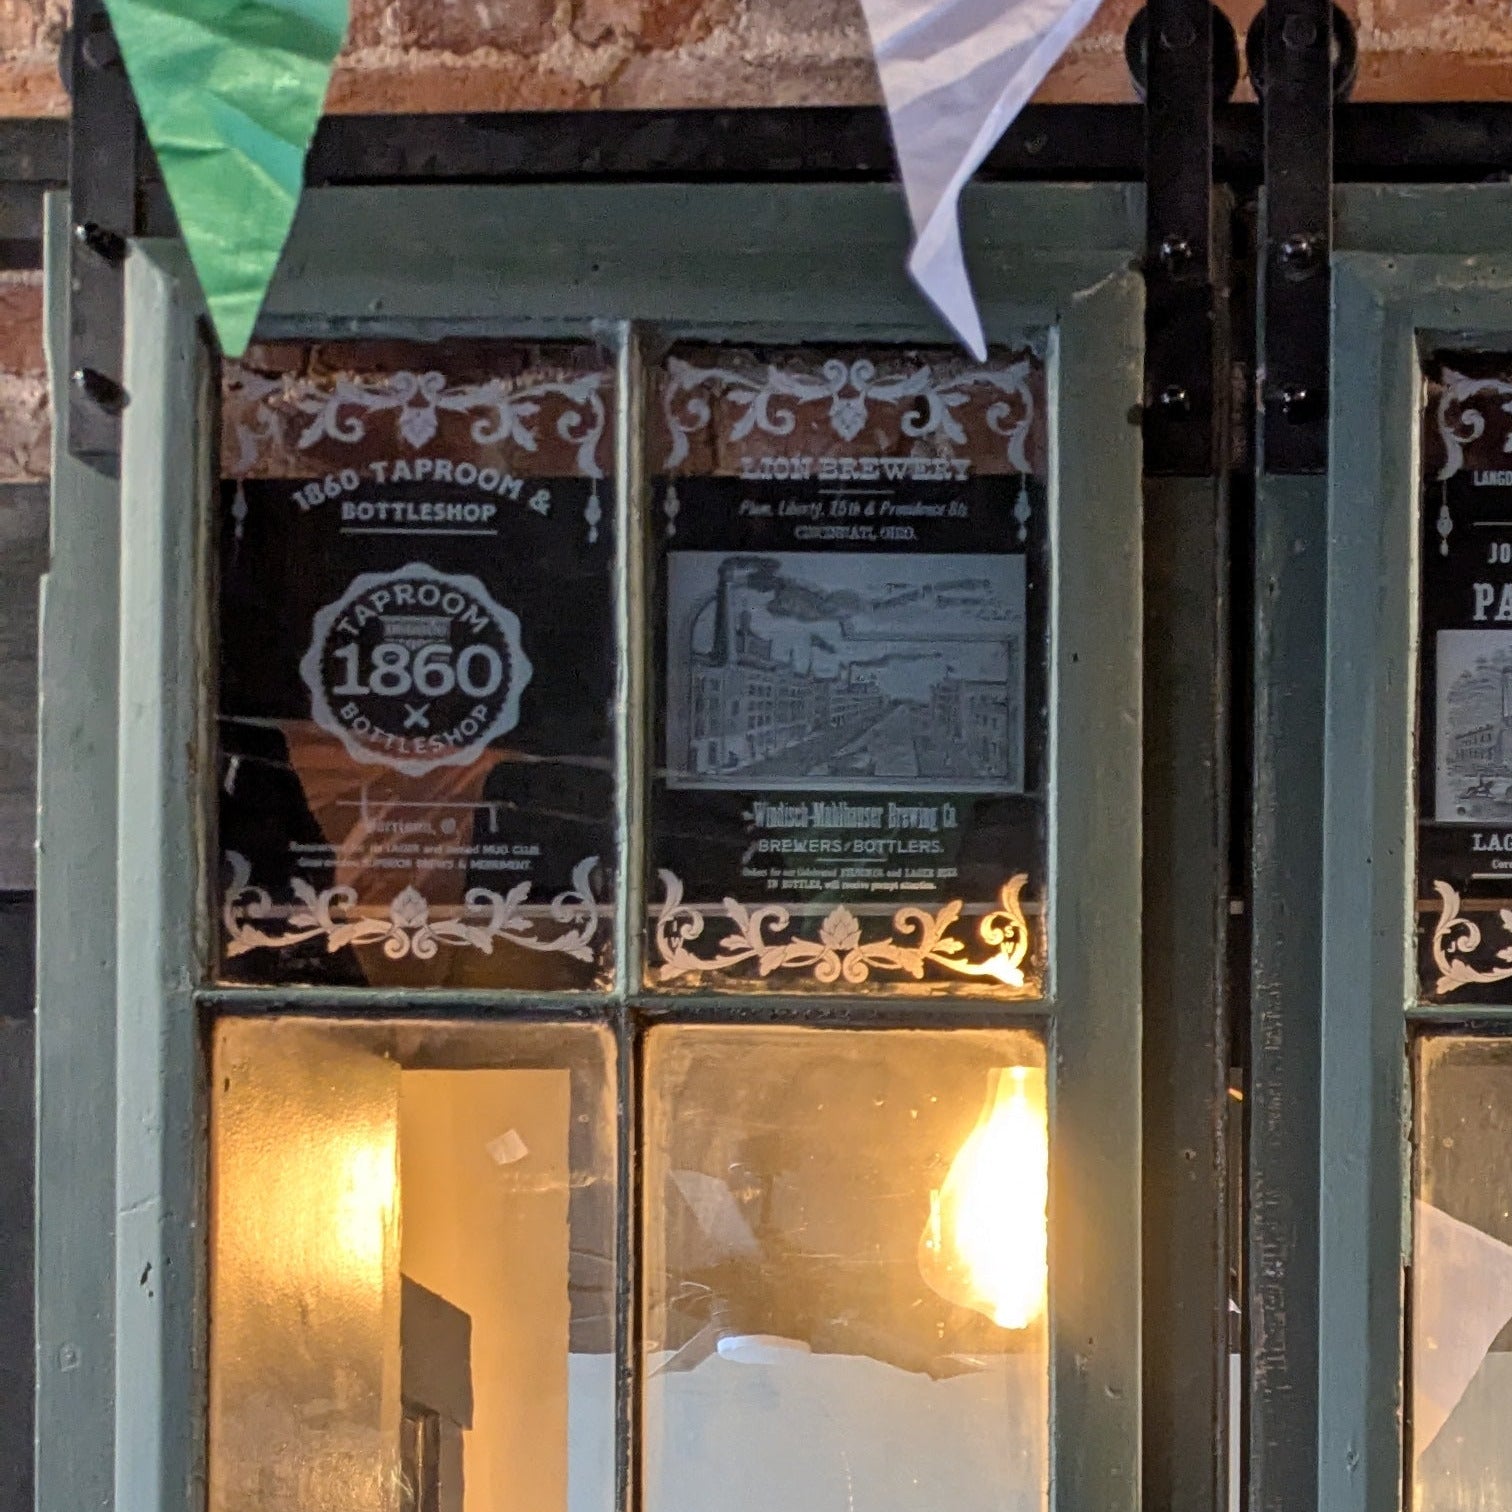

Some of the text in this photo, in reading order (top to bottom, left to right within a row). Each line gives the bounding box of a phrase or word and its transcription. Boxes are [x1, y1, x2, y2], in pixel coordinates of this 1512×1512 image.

[291, 458, 552, 516] 1860 TAPROOM &
[741, 456, 972, 481] LION BREWERY
[340, 501, 497, 522] BOTTLESHOP
[337, 583, 490, 636] TAPROOM
[333, 642, 503, 698] 1860
[339, 701, 489, 754] BOTTLESHOP
[758, 838, 842, 853] BREWERS
